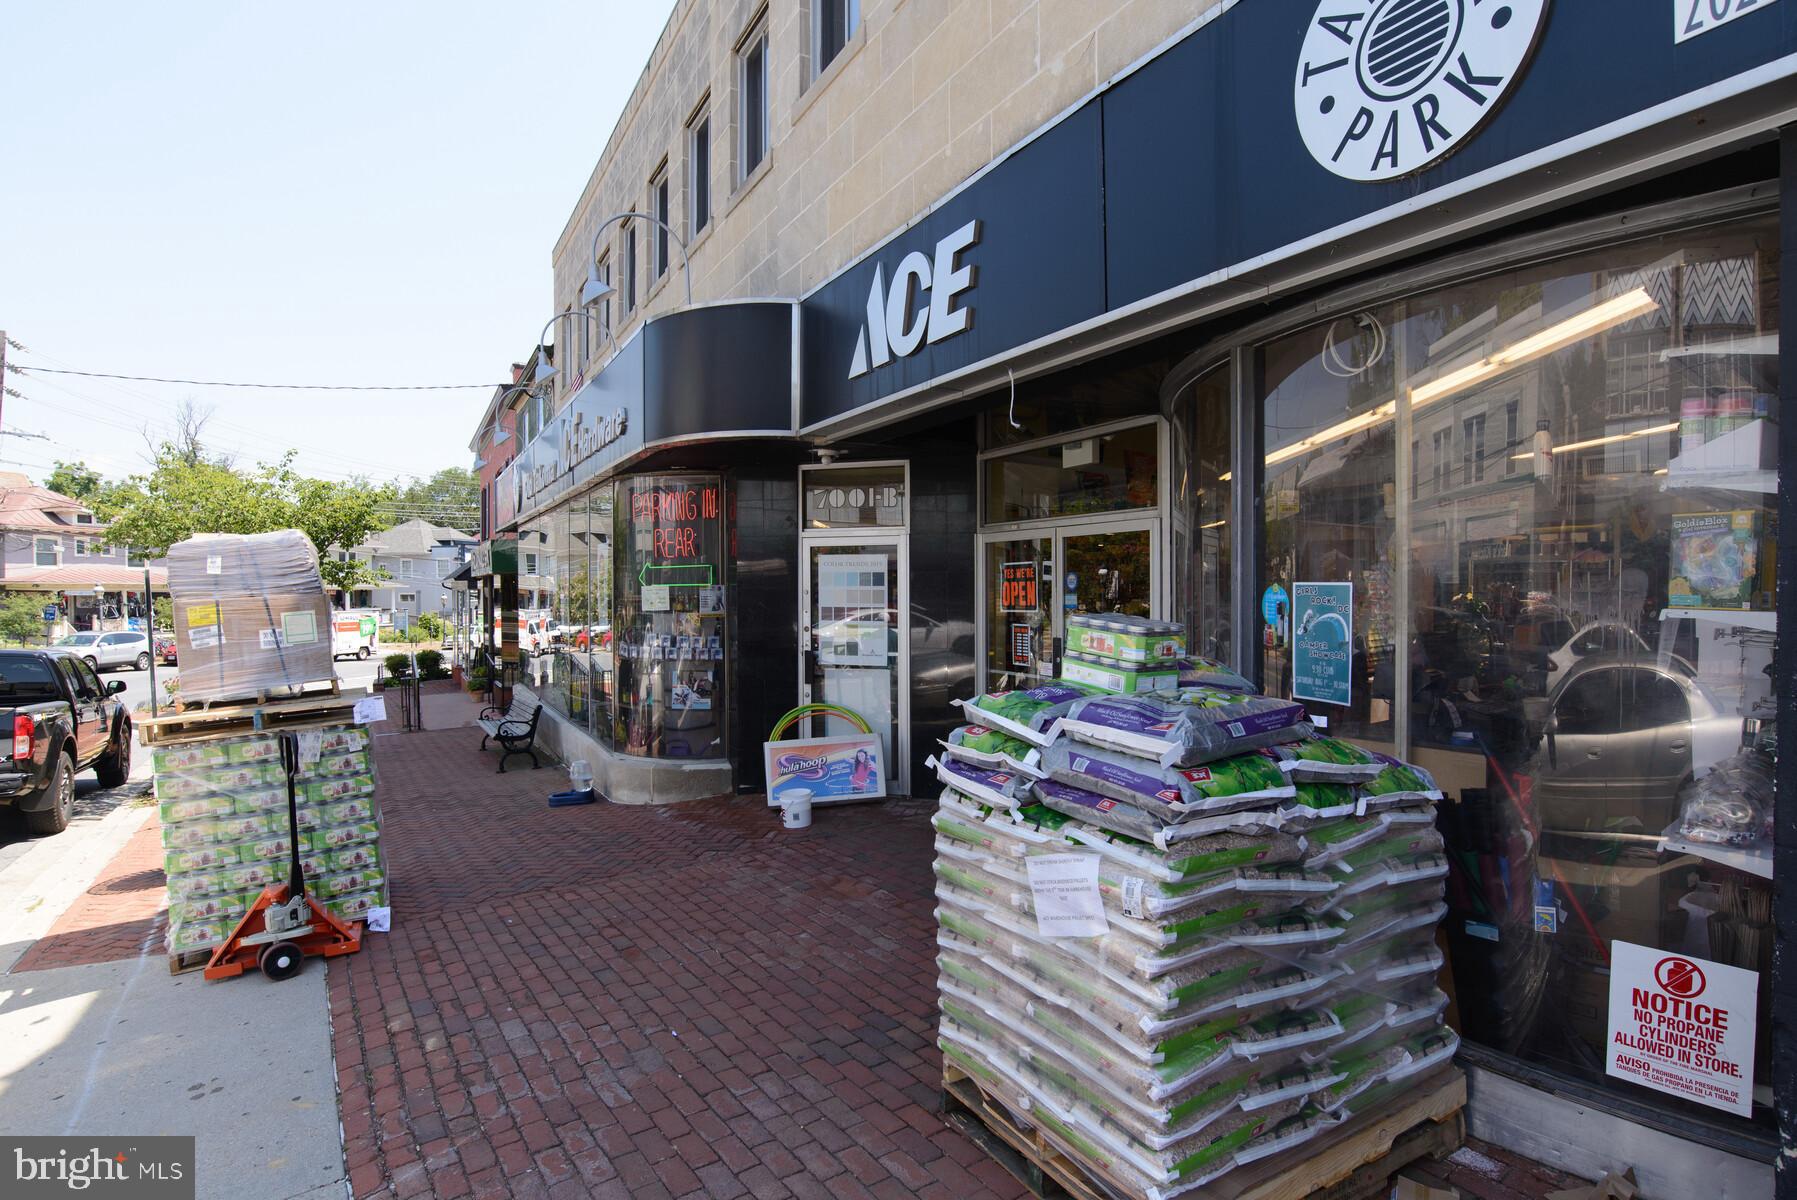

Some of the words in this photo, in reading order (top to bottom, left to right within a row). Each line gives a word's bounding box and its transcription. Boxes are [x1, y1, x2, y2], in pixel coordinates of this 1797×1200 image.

[1331, 52, 1504, 171] PARK
[848, 219, 979, 380] ACE
[632, 491, 697, 522] PARKING
[702, 488, 718, 519] IN
[813, 487, 898, 509] 7001-B
[1673, 516, 1728, 529] GoldieBlox
[654, 528, 696, 558] REAR
[1004, 568, 1014, 578] YES
[1016, 567, 1034, 578] WE'RE
[1002, 581, 1035, 607] OPEN
[1296, 587, 1318, 595] GIRLS
[1311, 596, 1336, 605] ROCK!
[1337, 605, 1350, 613] DC
[1632, 988, 1728, 1030] NOTICE
[1634, 1009, 1652, 1025] NO
[1658, 1016, 1724, 1044] PROPANE
[1639, 1024, 1716, 1056] CYLINDERS
[1614, 1032, 1674, 1058] ALLOWED
[1678, 1049, 1690, 1063] IN
[1695, 1054, 1742, 1078] STORE.
[1616, 1054, 1650, 1071] AVISO
[1652, 1067, 1684, 1082] PROHIBIDA
[1695, 1080, 1729, 1095] PRESENCIA
[1616, 1063, 1641, 1075] TANQUES
[1652, 1074, 1664, 1082] GAS
[1664, 1078, 1693, 1091] PROPANO
[1695, 1086, 1702, 1094] EN
